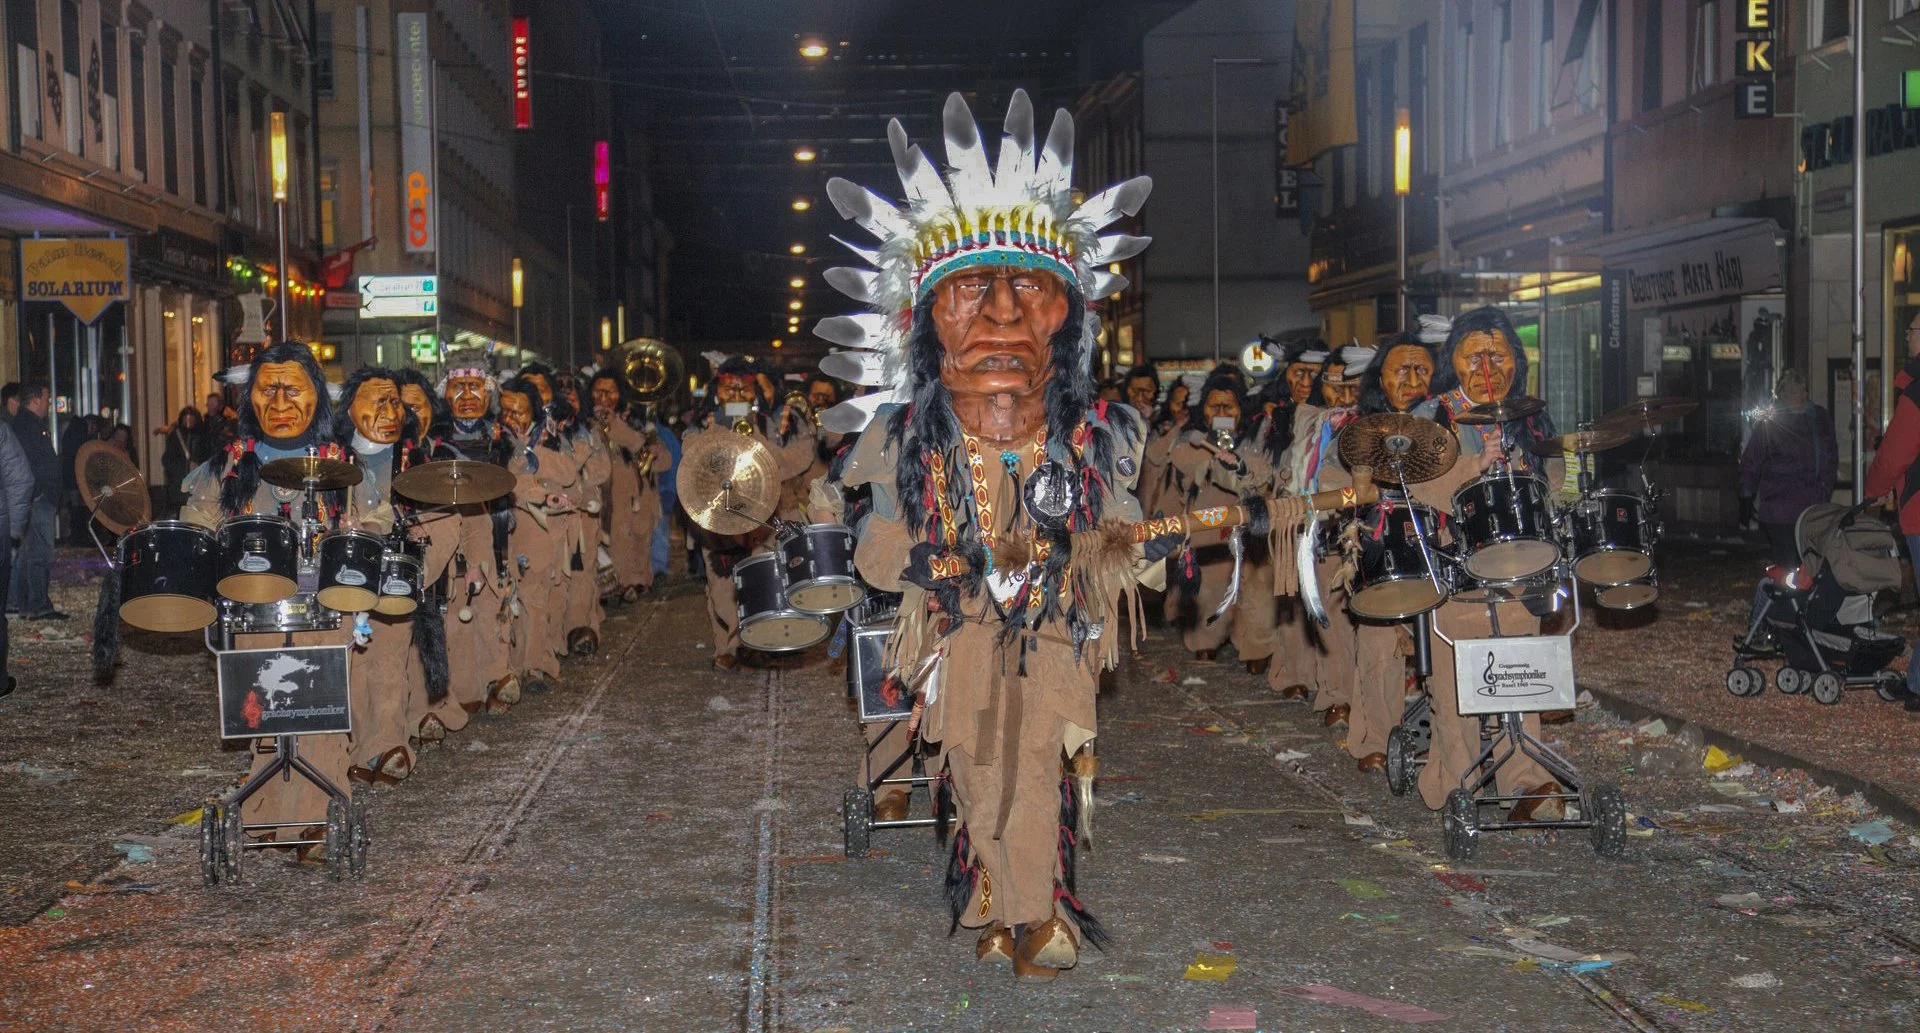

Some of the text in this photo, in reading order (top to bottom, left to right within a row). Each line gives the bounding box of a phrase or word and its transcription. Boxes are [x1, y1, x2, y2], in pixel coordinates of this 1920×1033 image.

[515, 36, 528, 99] EUROPE
[408, 171, 431, 248] coop
[28, 281, 123, 296] SOLARIUM
